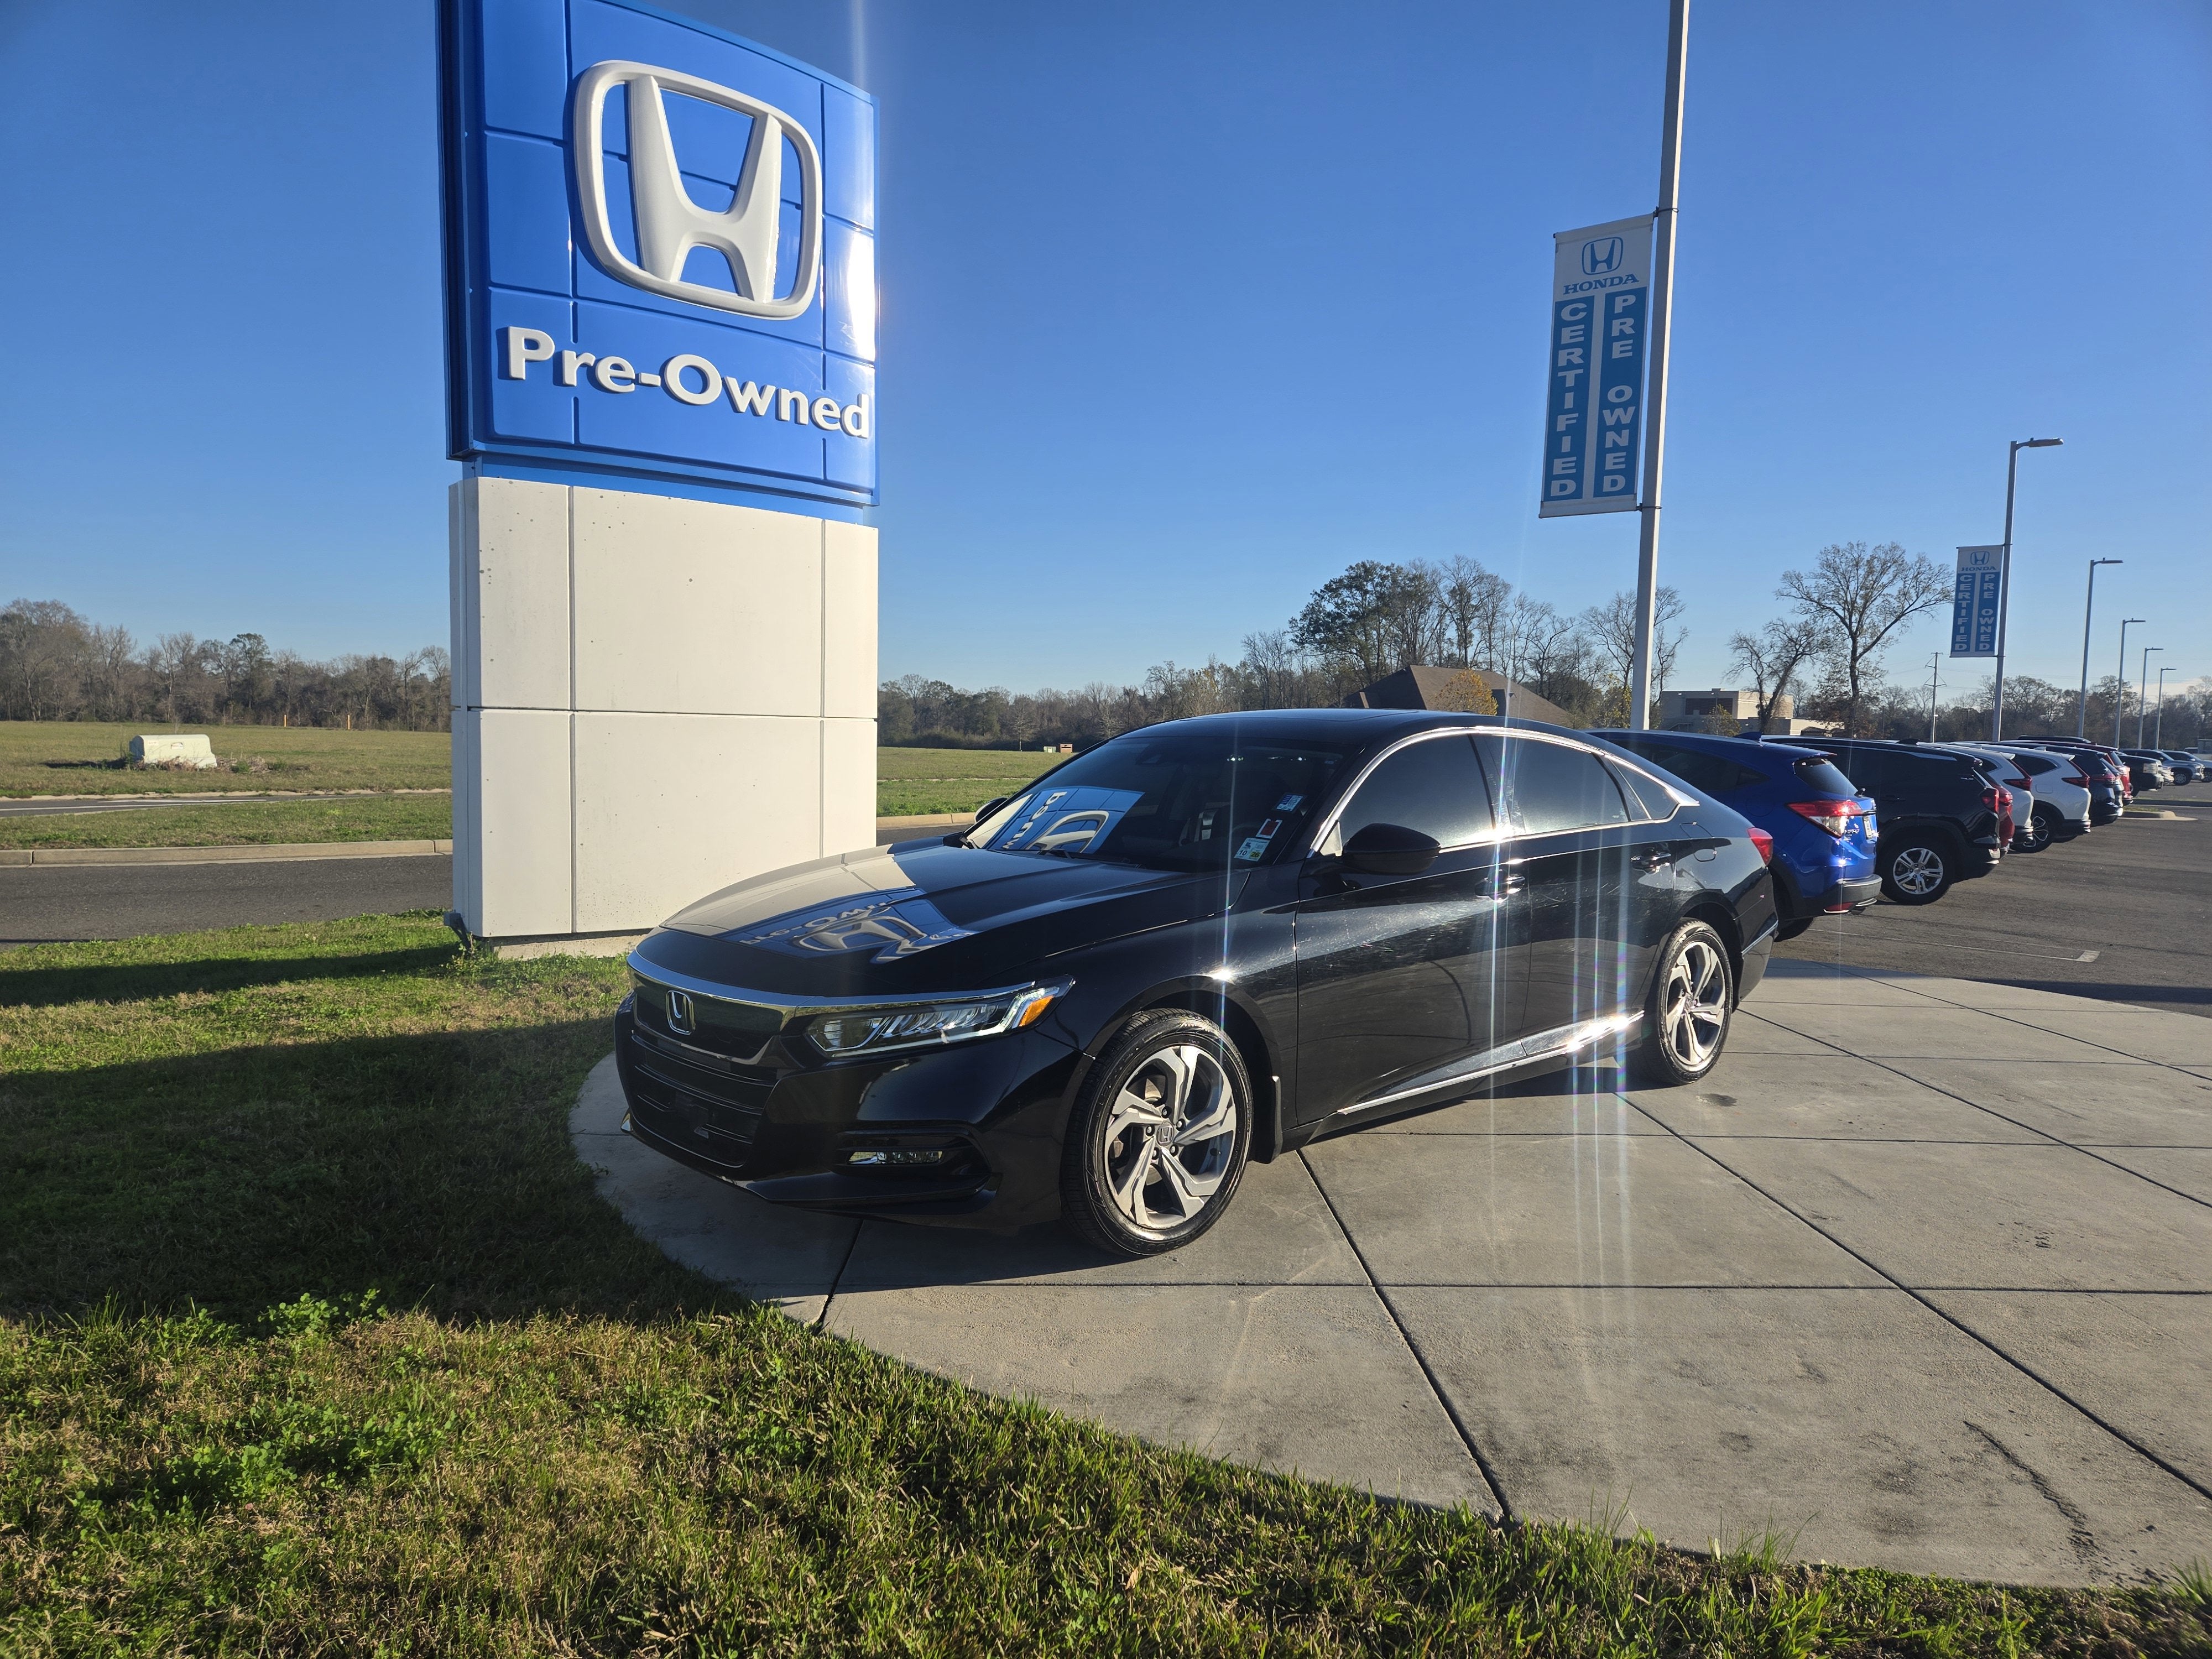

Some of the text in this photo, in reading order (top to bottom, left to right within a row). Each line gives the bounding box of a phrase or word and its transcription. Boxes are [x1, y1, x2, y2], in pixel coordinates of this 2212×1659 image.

[1563, 273, 1639, 295] HONDA
[508, 326, 870, 439] Pre-Owned
[1550, 302, 1587, 497] CERTIFIED
[1603, 295, 1636, 492] PRE OWNED
[1954, 575, 1973, 650] CERTIFIED
[1979, 573, 1995, 650] PRE OWNED
